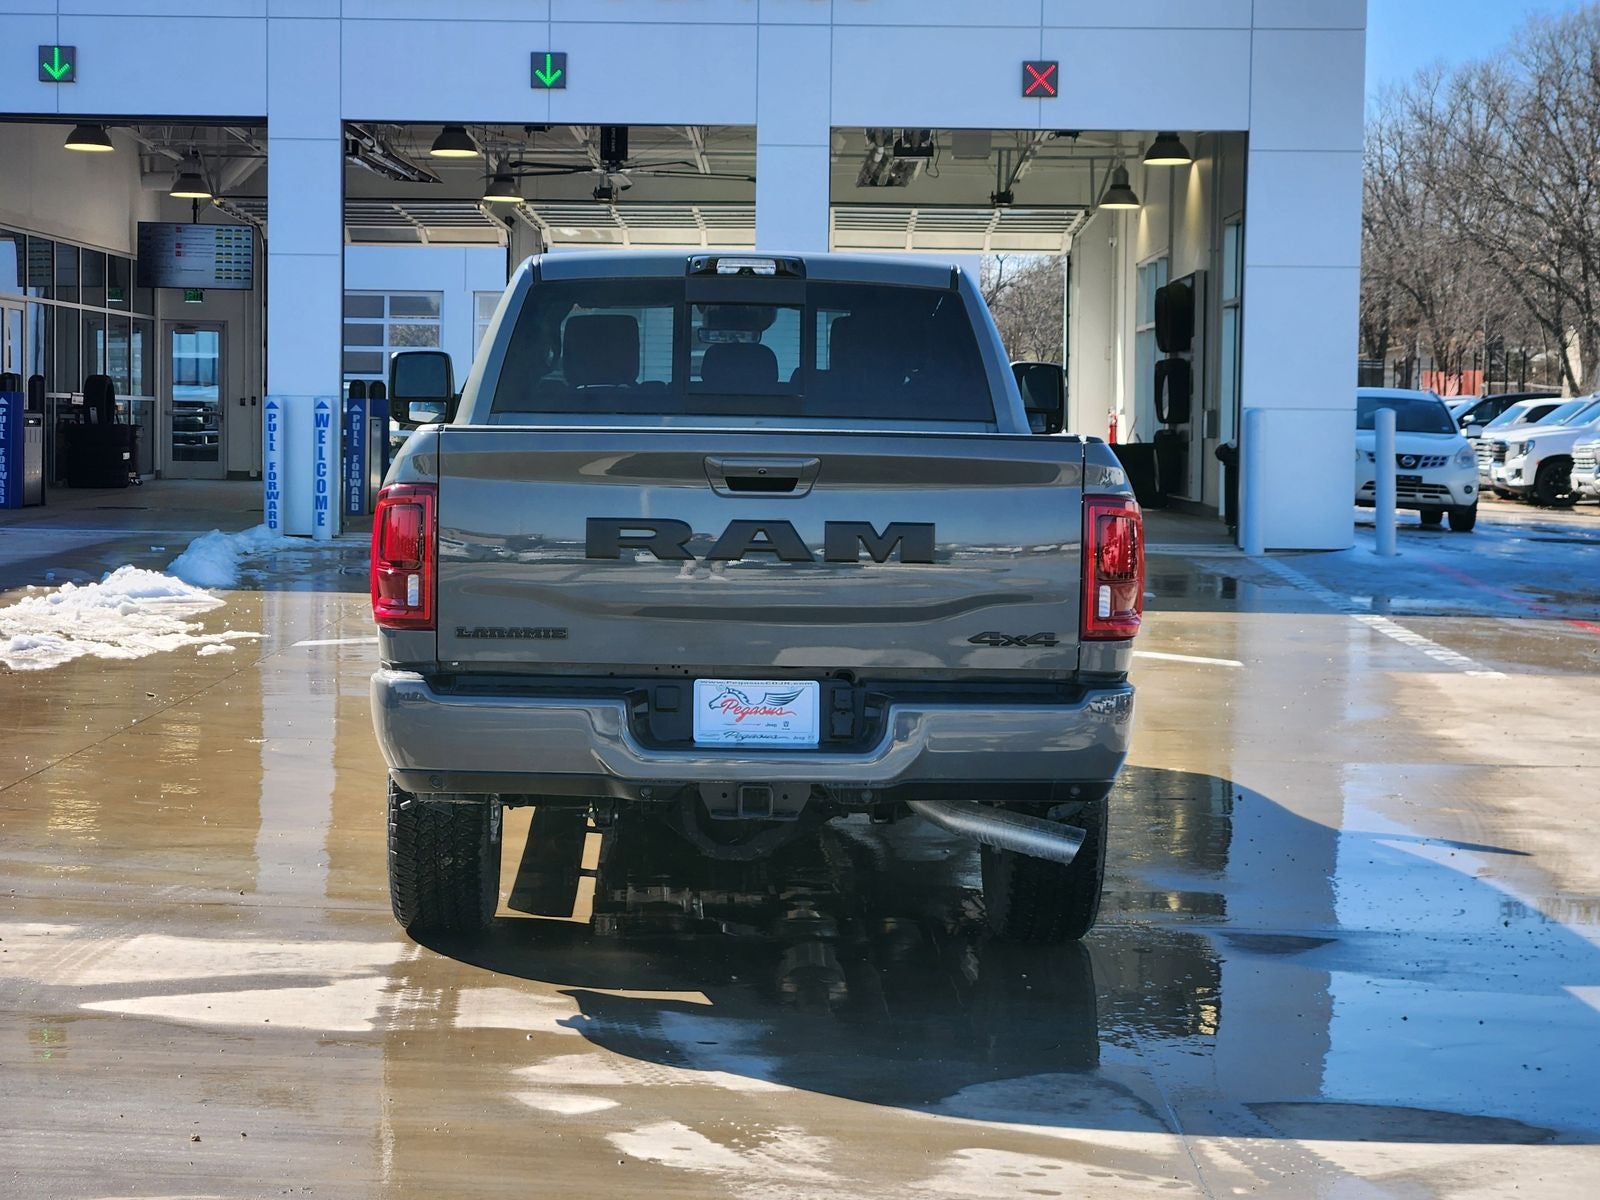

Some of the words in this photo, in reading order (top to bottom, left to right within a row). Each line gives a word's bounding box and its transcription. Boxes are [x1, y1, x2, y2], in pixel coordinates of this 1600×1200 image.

[267, 413, 277, 452] PULL
[351, 414, 361, 447] PULL
[315, 413, 330, 527] WELCOME
[349, 454, 362, 511] FORWARD
[266, 461, 280, 529] FORWARD
[586, 517, 936, 563] RAM
[721, 698, 798, 723] Pegasus
